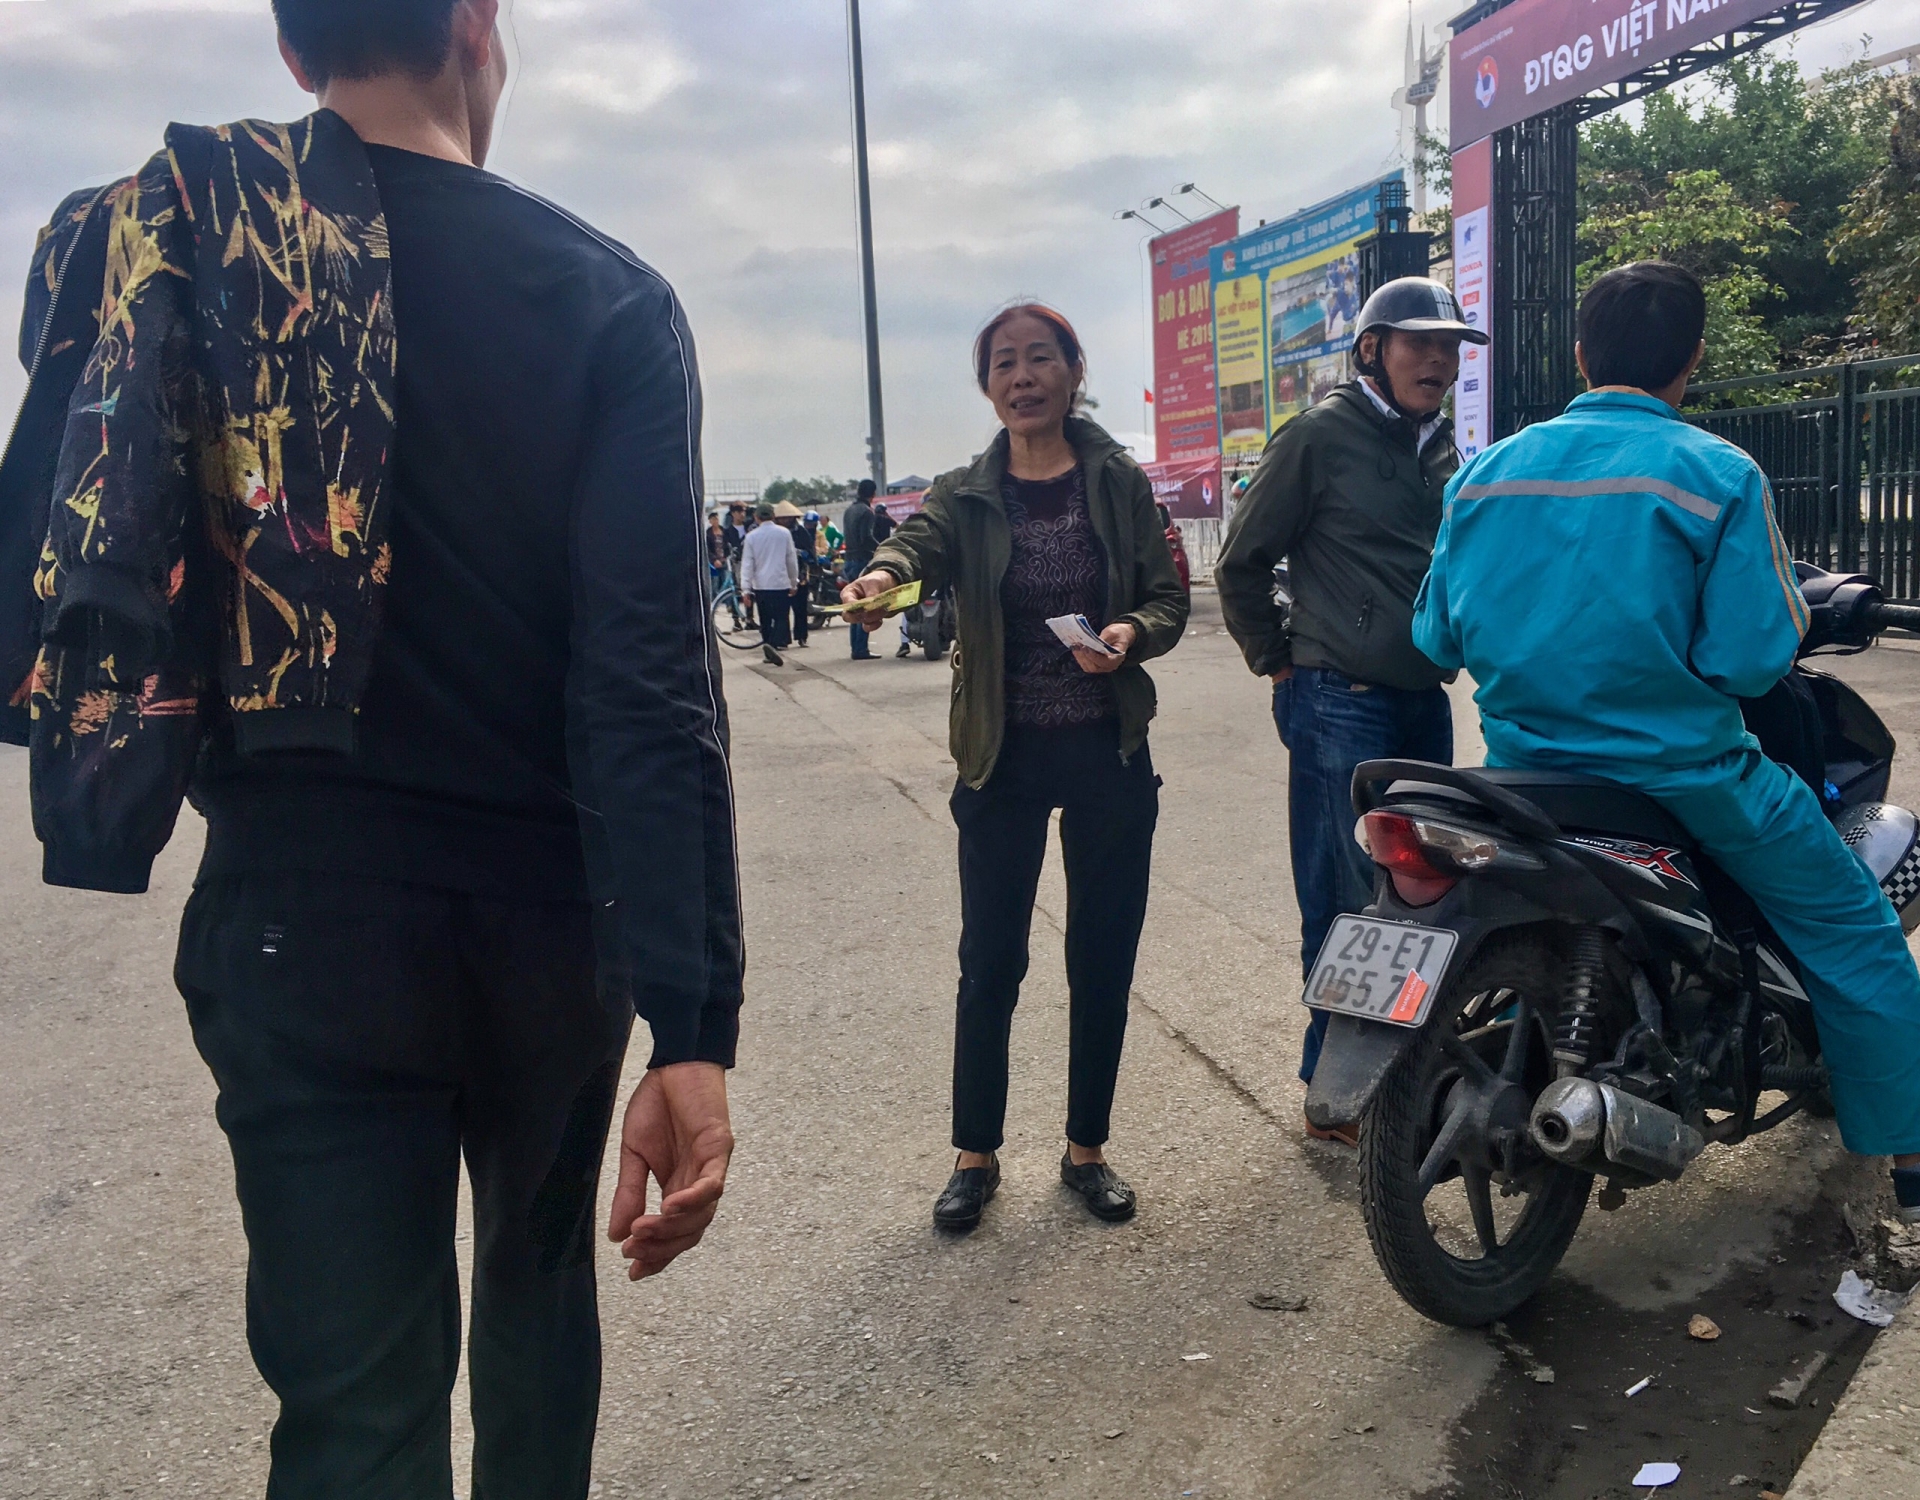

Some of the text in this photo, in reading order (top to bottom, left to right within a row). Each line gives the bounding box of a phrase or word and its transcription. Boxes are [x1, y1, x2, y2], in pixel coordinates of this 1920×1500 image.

[1524, 34, 1594, 95] ĐTQG
[1601, 0, 1658, 58] VIỆT
[1307, 219, 1328, 239] THAO
[1354, 199, 1370, 220] GIA
[1337, 924, 1435, 973] 29-E1
